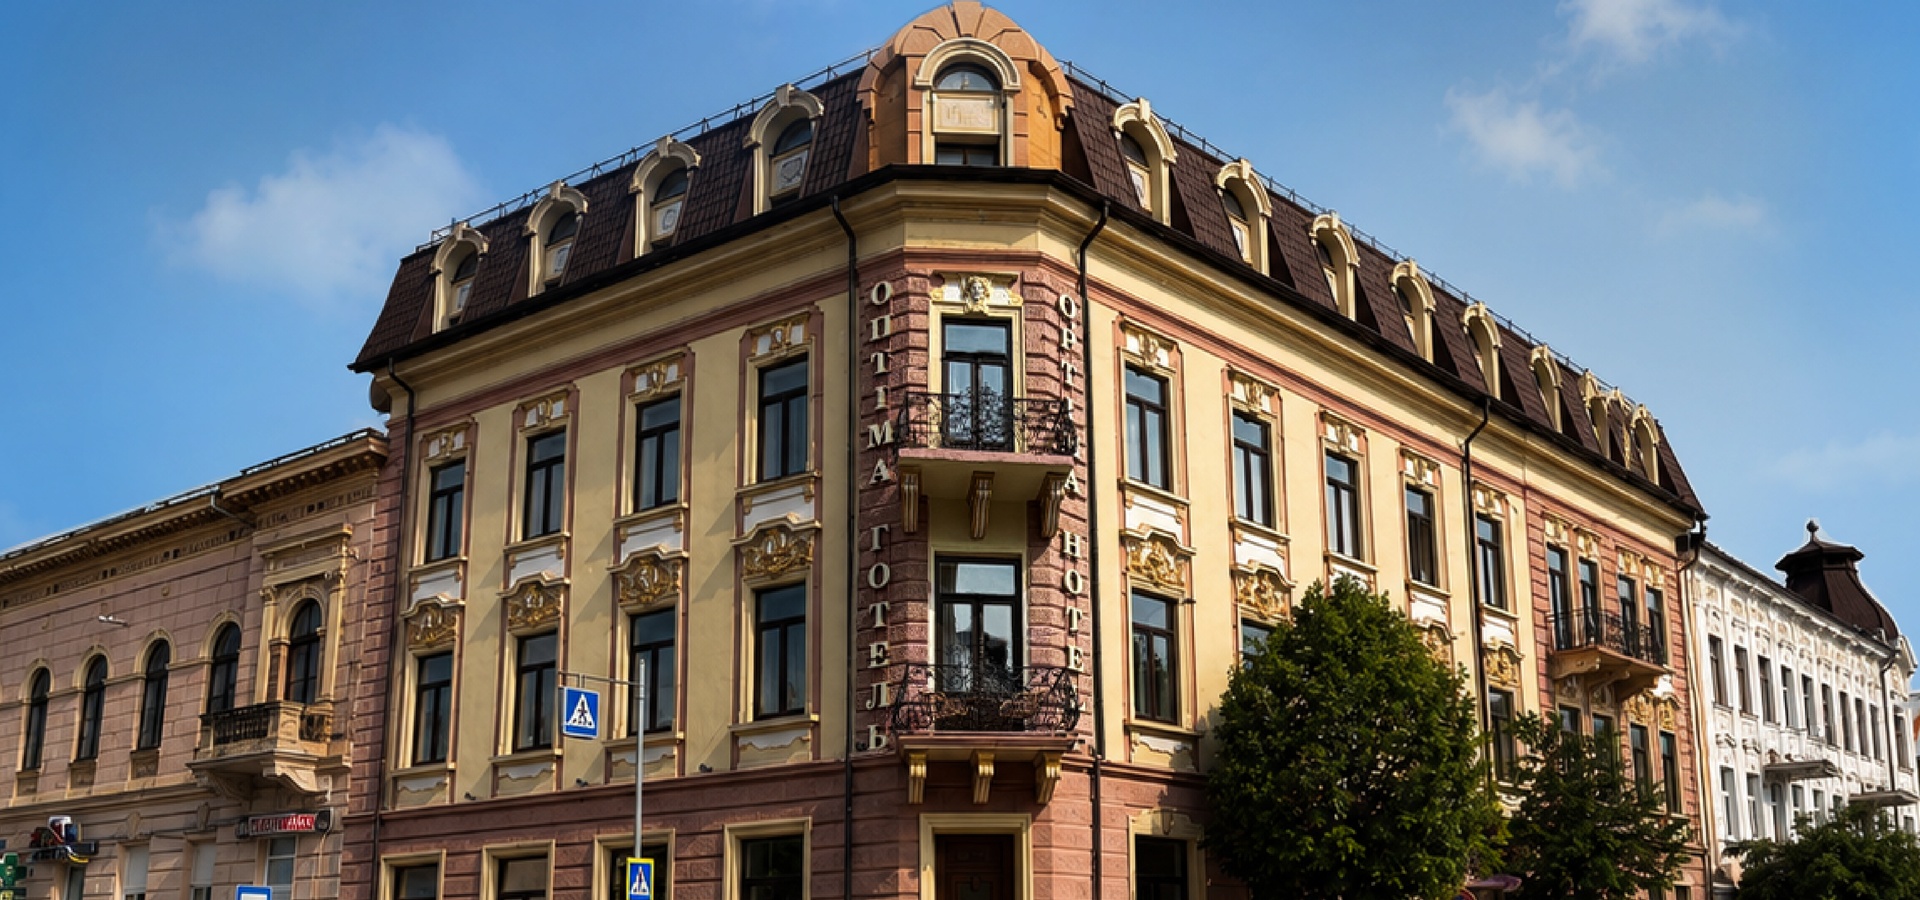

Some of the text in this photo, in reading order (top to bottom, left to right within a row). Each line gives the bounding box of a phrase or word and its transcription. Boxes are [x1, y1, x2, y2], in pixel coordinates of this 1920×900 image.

[866, 281, 895, 750] ОПТІМА ГОТЕЛЬ
[1059, 294, 1081, 494] OPTIA
